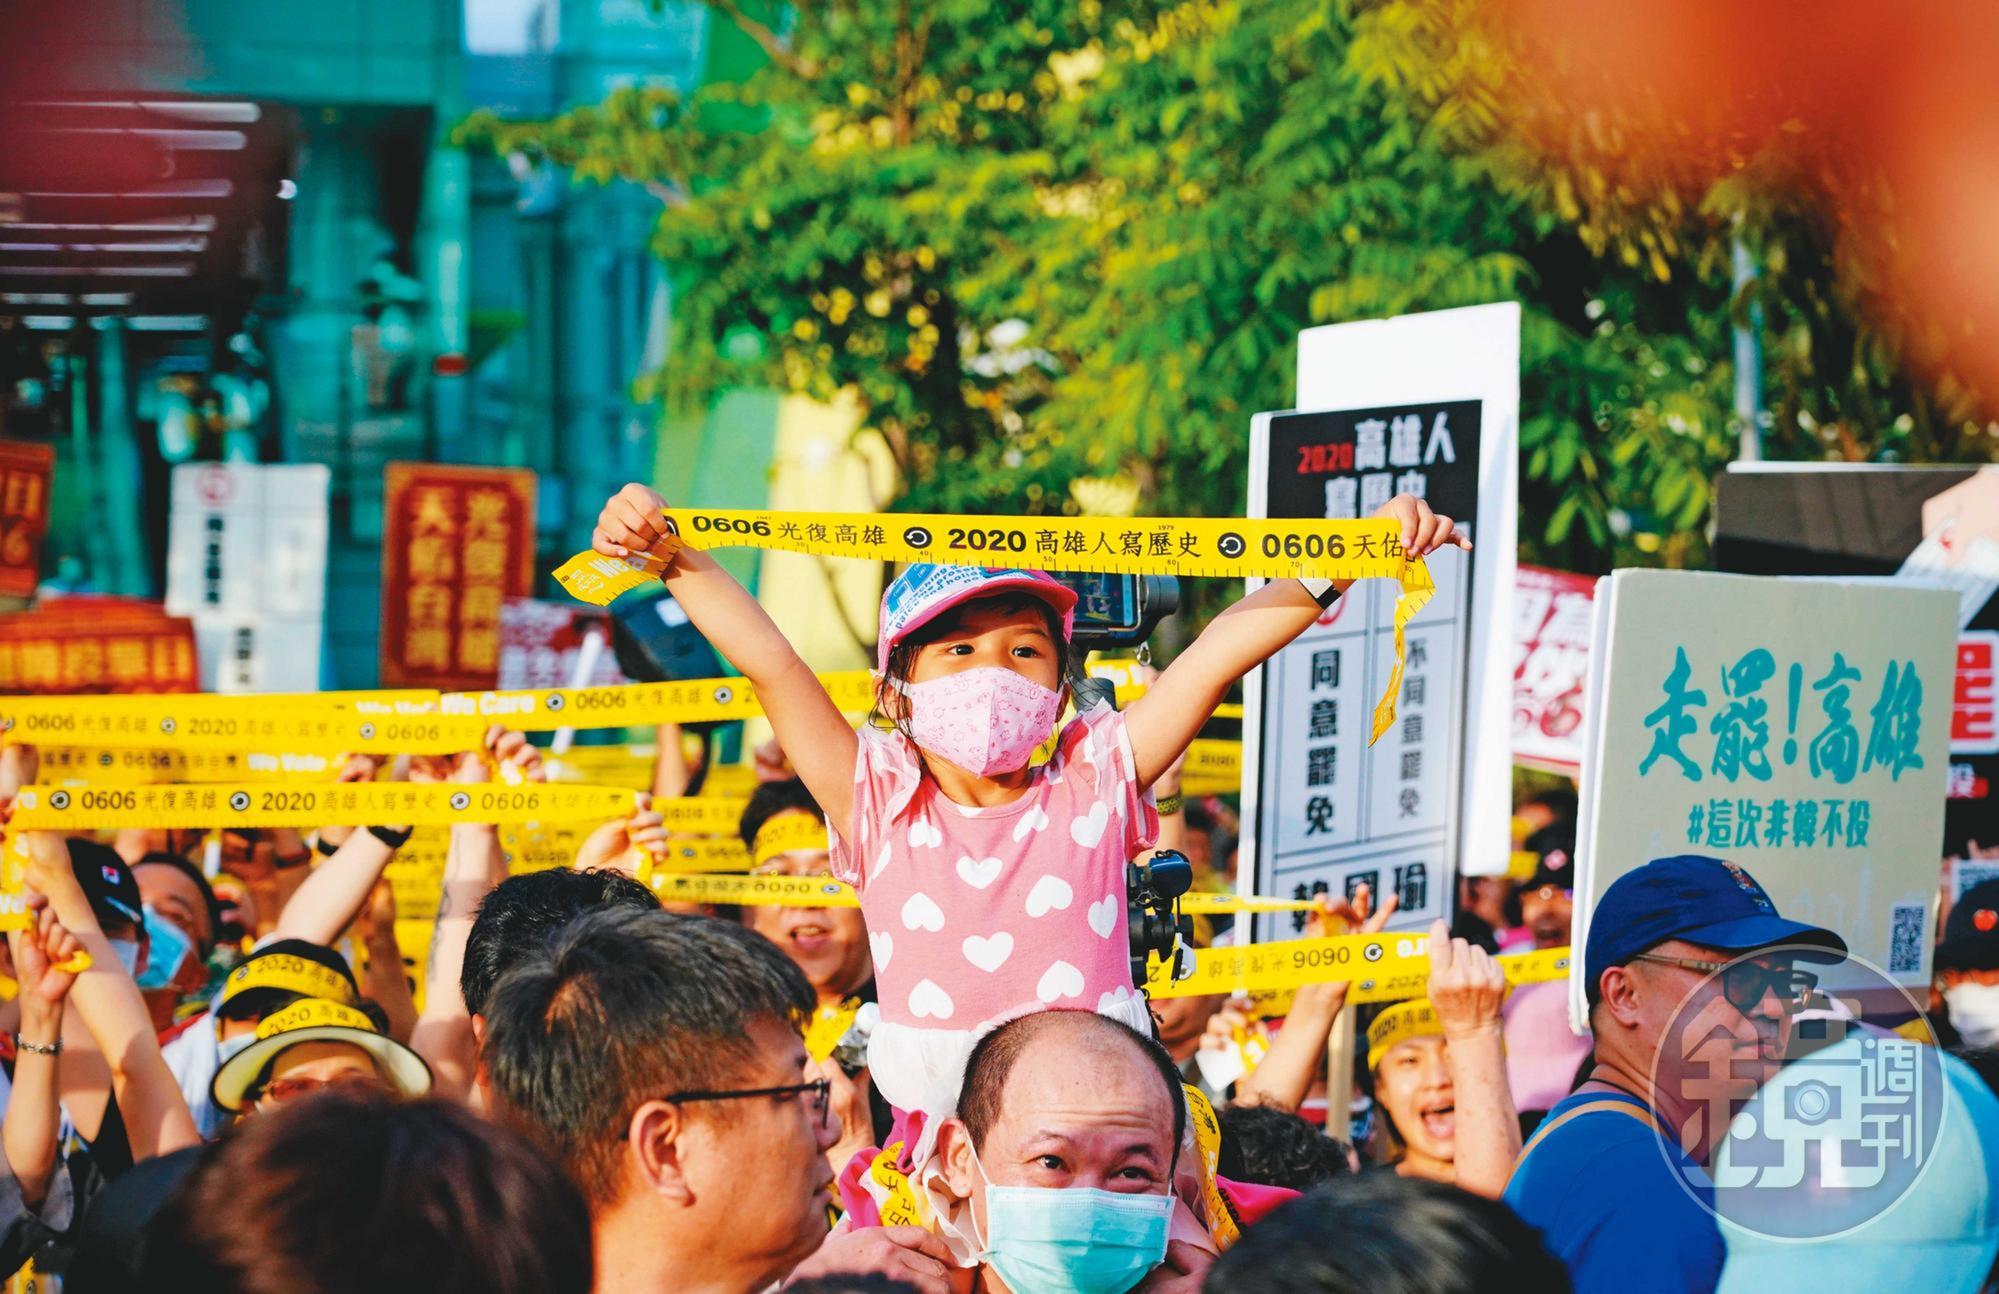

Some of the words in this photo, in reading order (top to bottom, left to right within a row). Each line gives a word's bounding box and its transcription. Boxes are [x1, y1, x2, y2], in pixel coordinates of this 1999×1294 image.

[692, 516, 771, 536] 0606
[777, 521, 887, 545] 光復高雄
[948, 528, 1026, 553] 2020
[1035, 529, 1201, 558] 高雄人寫歷史
[1262, 534, 1346, 559] 0606
[441, 692, 476, 715] We
[479, 691, 536, 714] Care
[576, 692, 627, 710] 0606
[1639, 646, 1924, 784] 走罷!高雄
[26, 714, 76, 731] 0606
[188, 719, 238, 736] 2020
[387, 724, 440, 741] 0606
[1306, 649, 1341, 836] 同意罷免
[1397, 637, 1428, 819] 不同意罷免
[81, 791, 136, 810] 0606
[142, 791, 218, 811] 光復高雄
[262, 792, 316, 811] 2020
[323, 791, 438, 811] 高雄人寫歷史
[481, 792, 540, 811] 0606
[1687, 799, 1871, 849] #這次非韓不投
[1293, 946, 1350, 969] 0606
